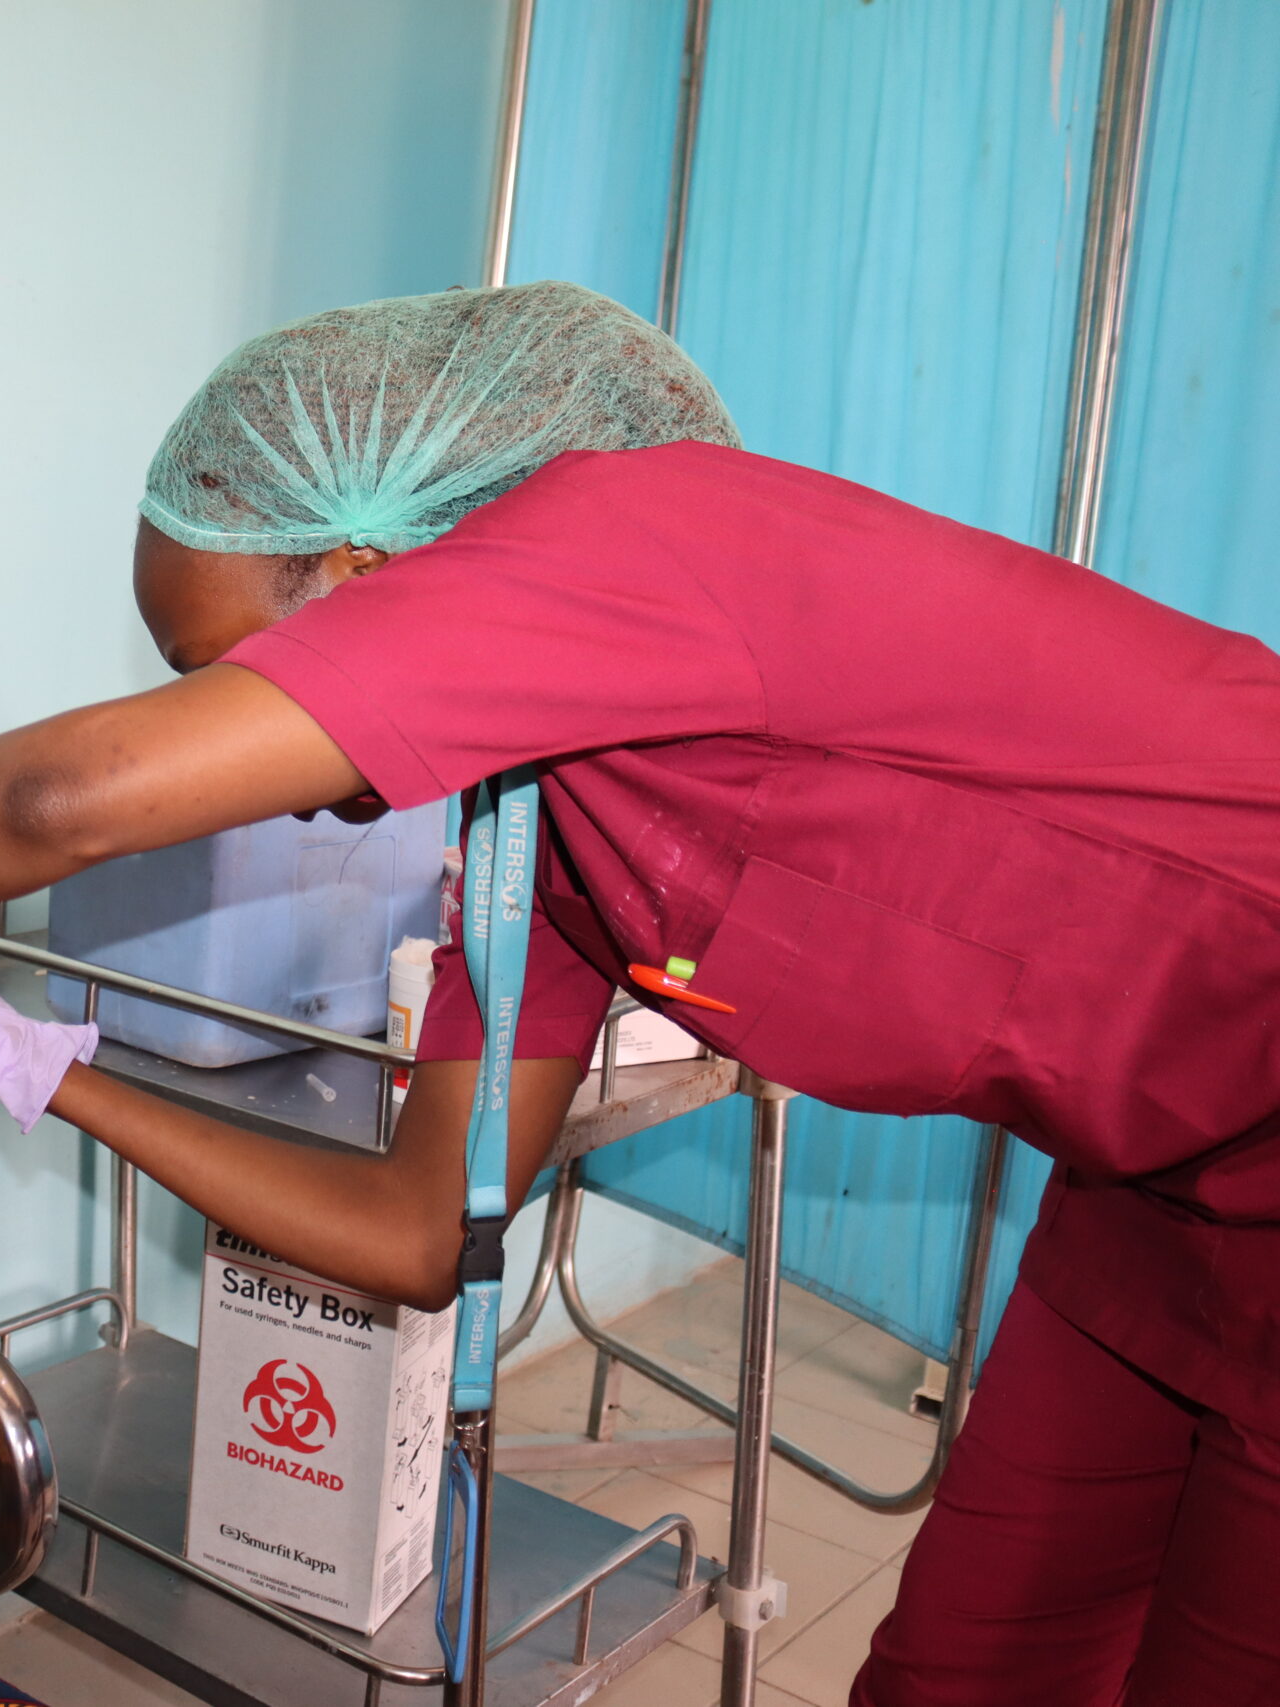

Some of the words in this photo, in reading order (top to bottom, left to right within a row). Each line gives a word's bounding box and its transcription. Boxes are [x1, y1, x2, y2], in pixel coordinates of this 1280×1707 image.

[222, 1267, 309, 1318] Safety
[320, 1293, 376, 1332] Box
[219, 1300, 233, 1311] For
[234, 1304, 253, 1318] used
[255, 1311, 290, 1329] syringes,
[292, 1322, 324, 1338] needles
[326, 1331, 342, 1342] and
[344, 1336, 372, 1351] sharps
[227, 1441, 344, 1492] BIOHAZARD
[242, 1532, 291, 1559] Smurfit
[293, 1549, 336, 1574] Kappa
